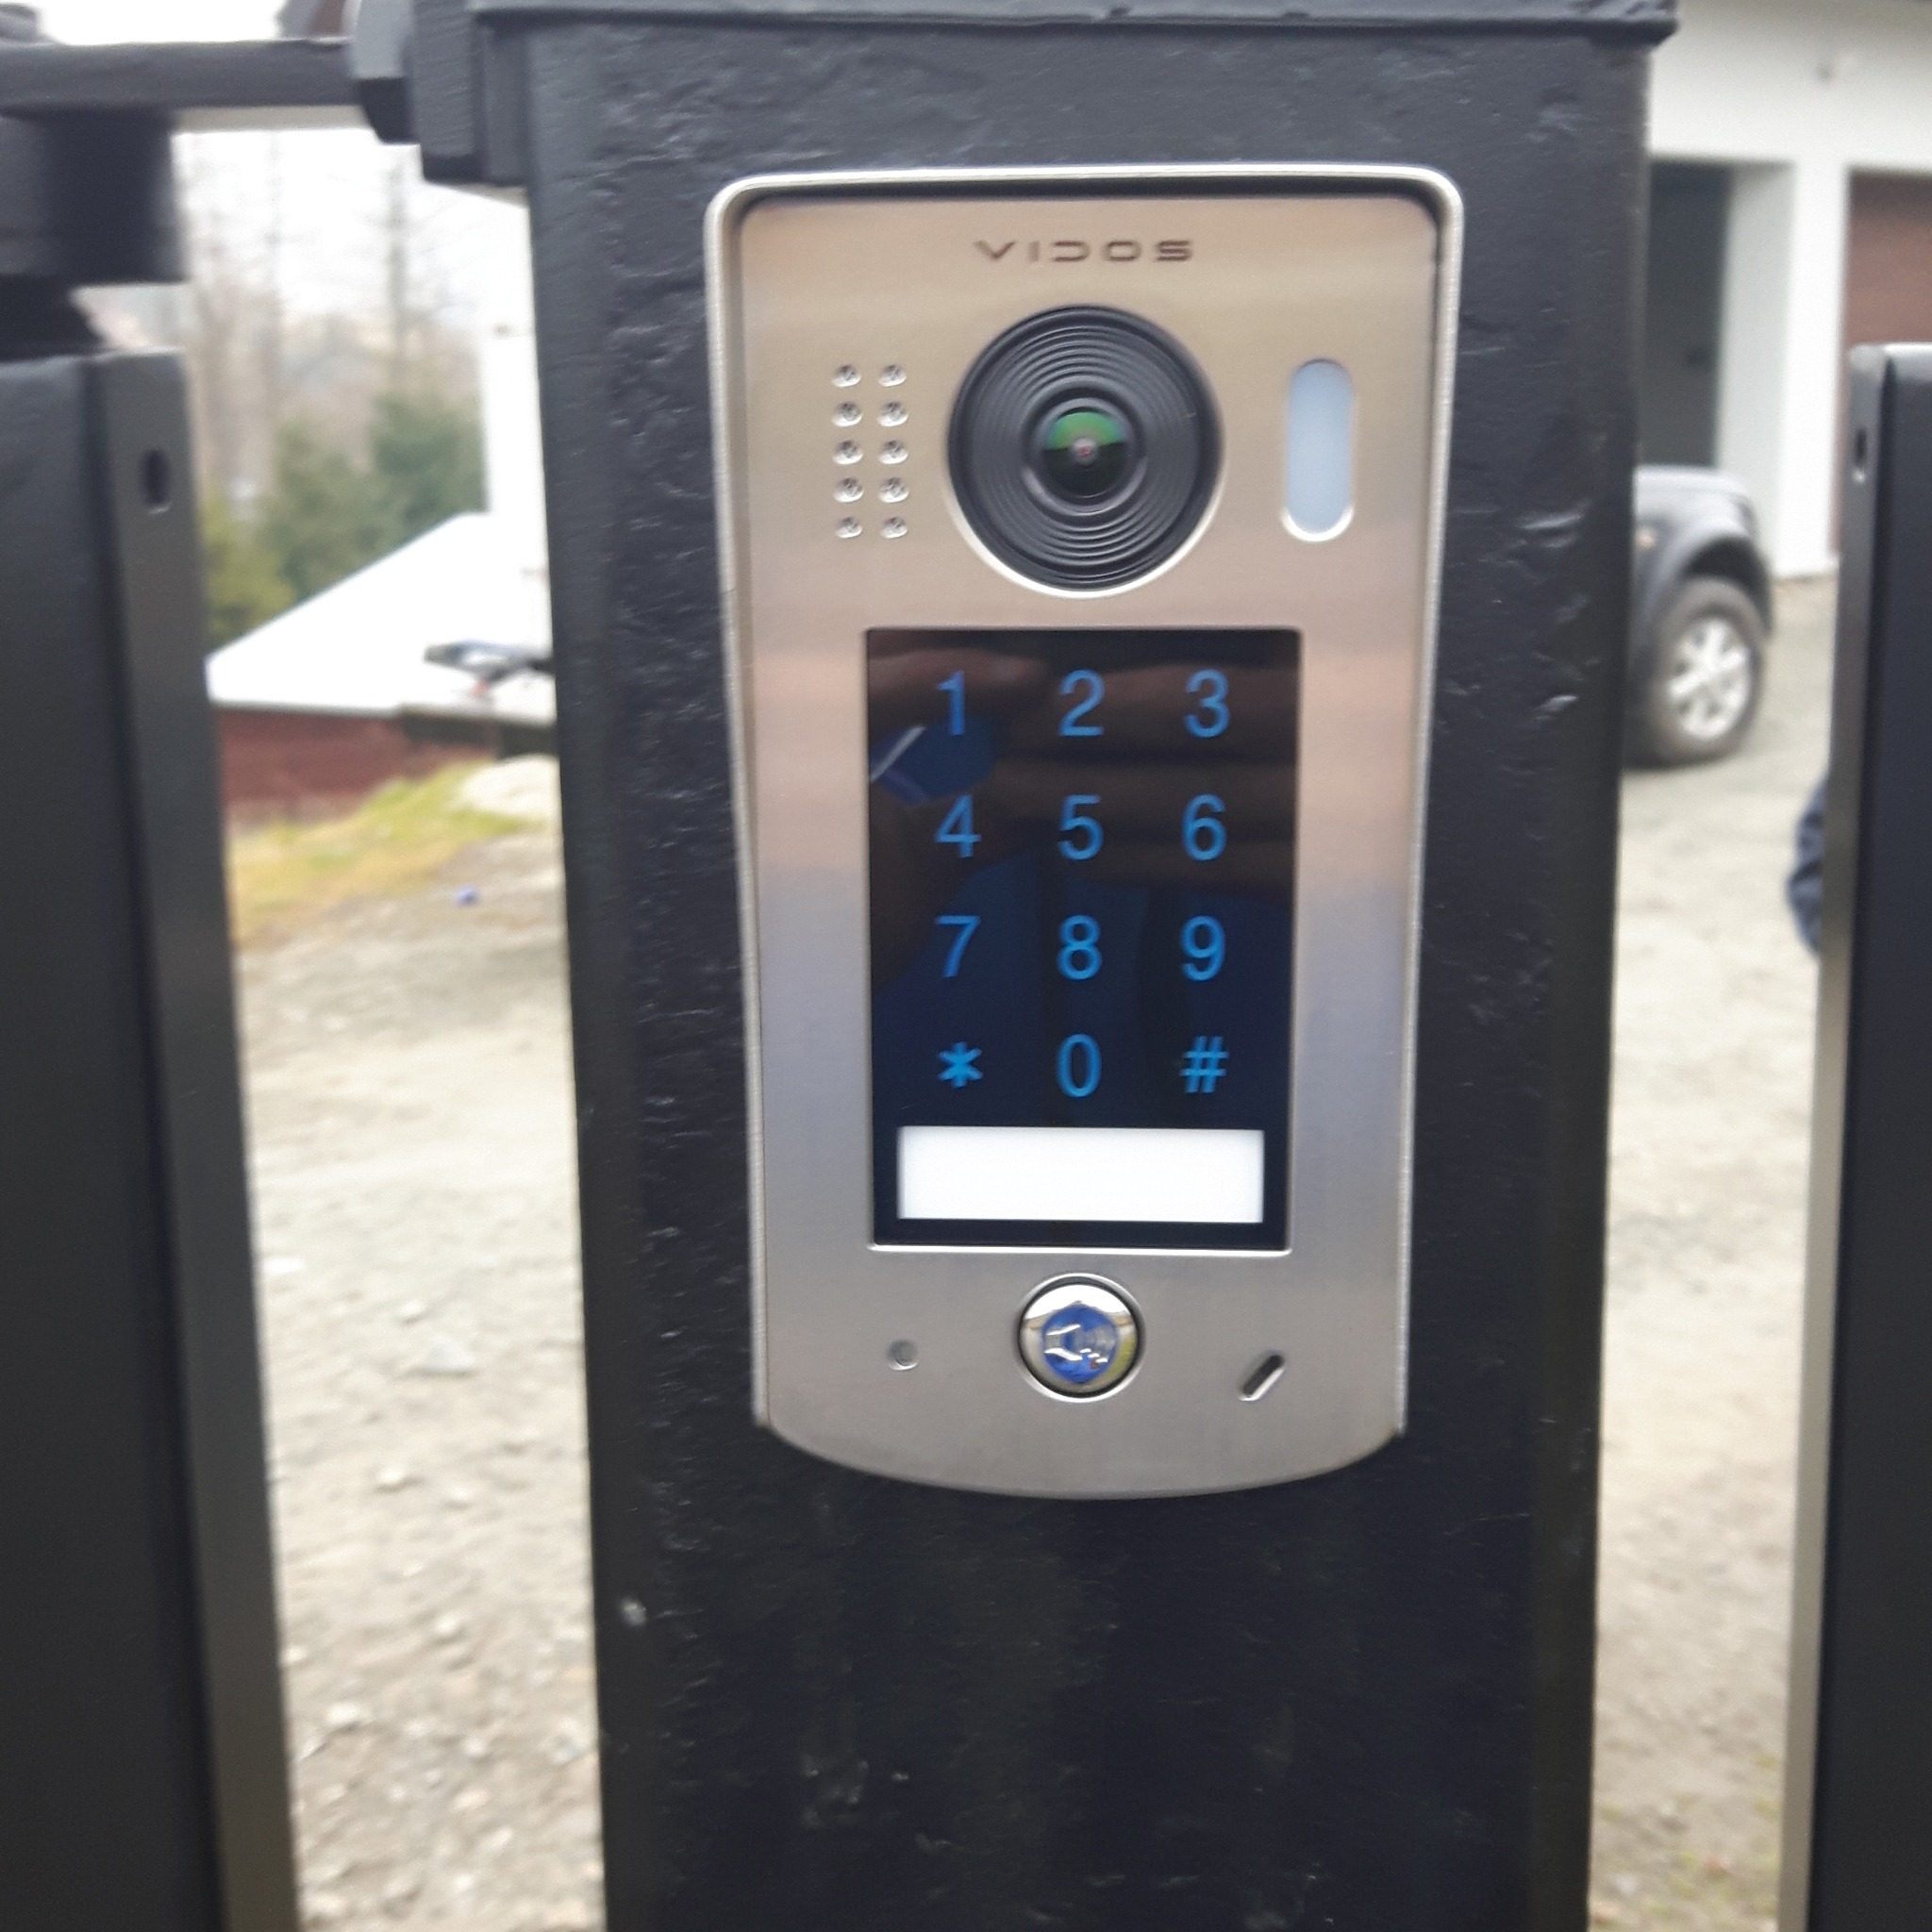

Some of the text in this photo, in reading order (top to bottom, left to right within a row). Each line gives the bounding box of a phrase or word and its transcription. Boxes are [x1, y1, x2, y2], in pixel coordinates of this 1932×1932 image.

[974, 240, 1194, 262] VIDOS
[937, 670, 1230, 738] 1 2 3
[936, 793, 1226, 860] 4 5 6
[936, 915, 1225, 981] 7 8 9
[1057, 1034, 1101, 1098] 0
[1181, 1036, 1229, 1094] #
